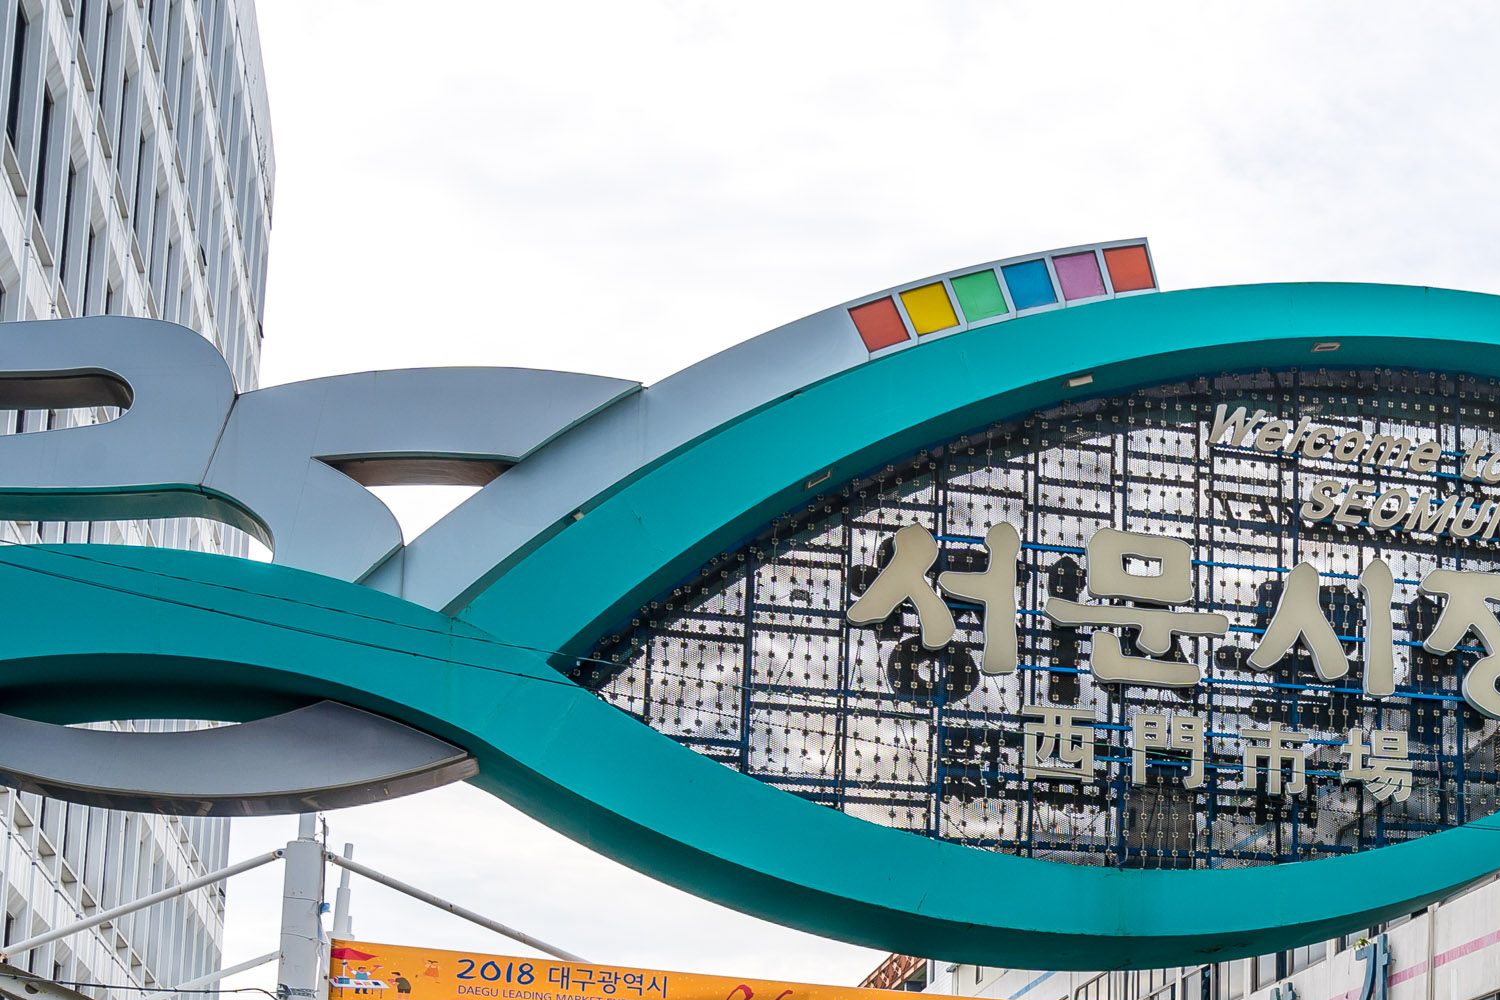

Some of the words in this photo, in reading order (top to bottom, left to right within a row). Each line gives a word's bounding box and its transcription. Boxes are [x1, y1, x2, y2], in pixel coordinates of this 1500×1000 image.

[1209, 403, 1438, 472] Welcome
[1022, 706, 1414, 802] 西門市場
[456, 959, 535, 985] 2018
[548, 966, 668, 999] 대구광역시
[458, 985, 499, 998] DAEGU
